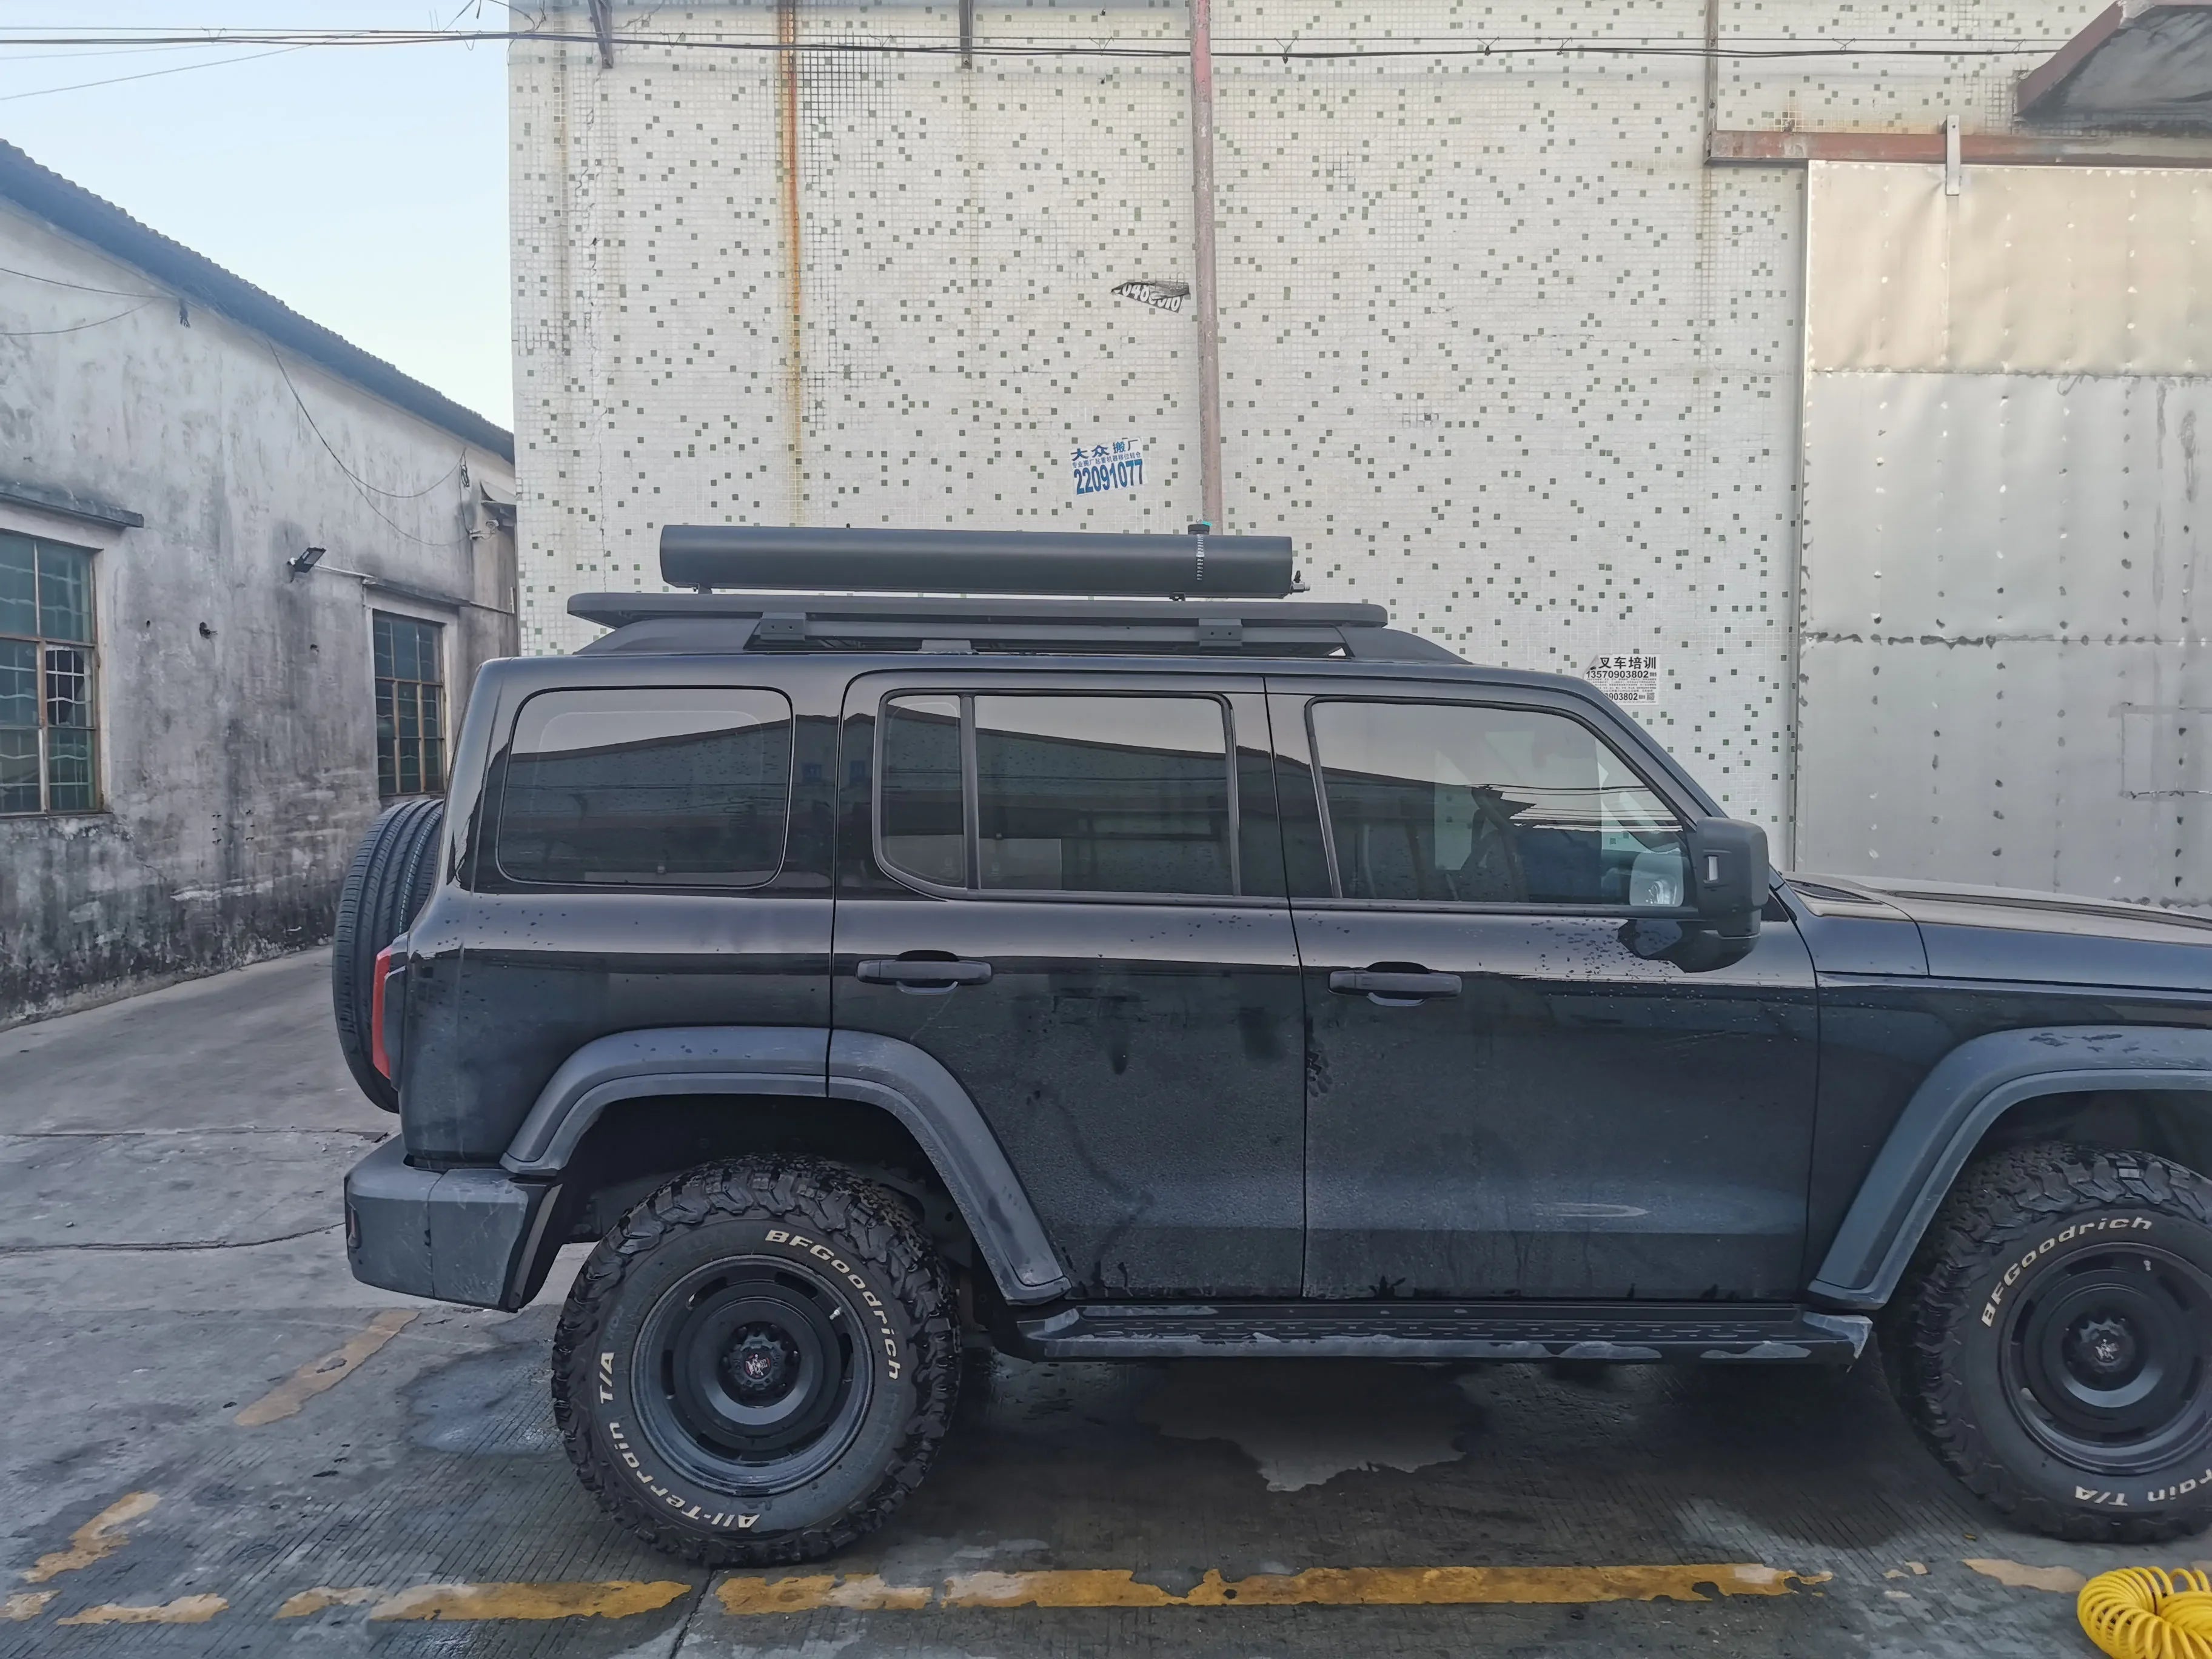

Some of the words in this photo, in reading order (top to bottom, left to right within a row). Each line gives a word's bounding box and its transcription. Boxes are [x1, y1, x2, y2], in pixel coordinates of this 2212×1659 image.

[1074, 458, 1143, 495] 22091077
[1586, 670, 1649, 679] 13570903802
[1598, 656, 1657, 669] 叉车培训
[1605, 692, 1638, 701] 903802
[1981, 1216, 2153, 1327] BFGoodrich
[765, 1229, 901, 1380] BFGoodrich
[598, 1352, 615, 1404] T/A
[610, 1422, 760, 1528] All-Terrain
[2075, 1486, 2128, 1506] T/A
